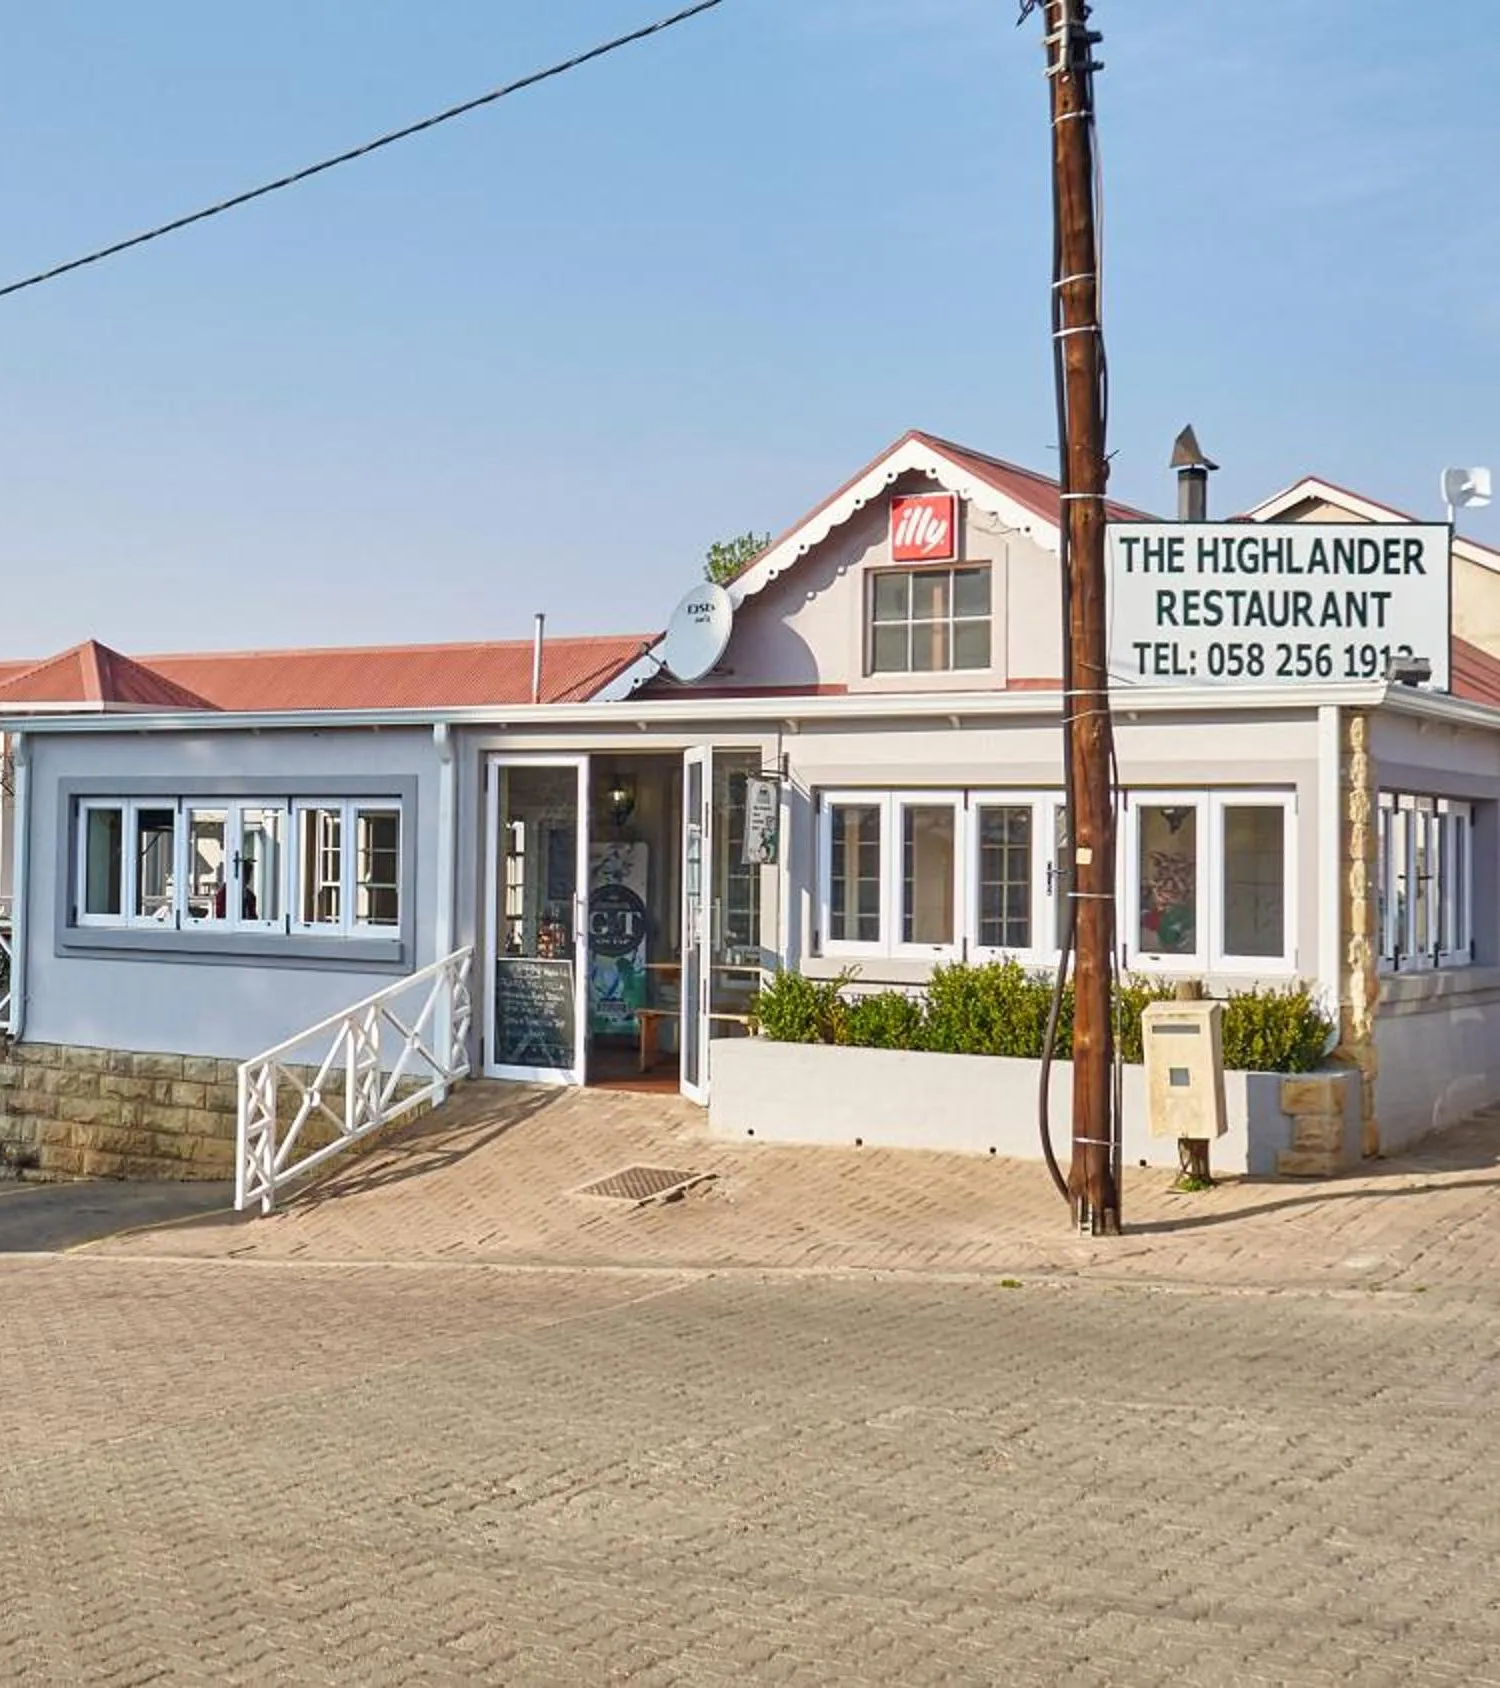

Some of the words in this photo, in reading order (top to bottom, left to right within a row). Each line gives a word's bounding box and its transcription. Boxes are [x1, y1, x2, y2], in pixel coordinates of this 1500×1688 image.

[894, 506, 949, 555] illy
[1119, 537, 1185, 573] THE
[1197, 537, 1427, 575] HIGHLANDER
[1156, 589, 1392, 628] RESTAURANT
[1133, 642, 1197, 675] TEL:
[1207, 642, 1265, 676] 058
[1276, 643, 1333, 677] 256
